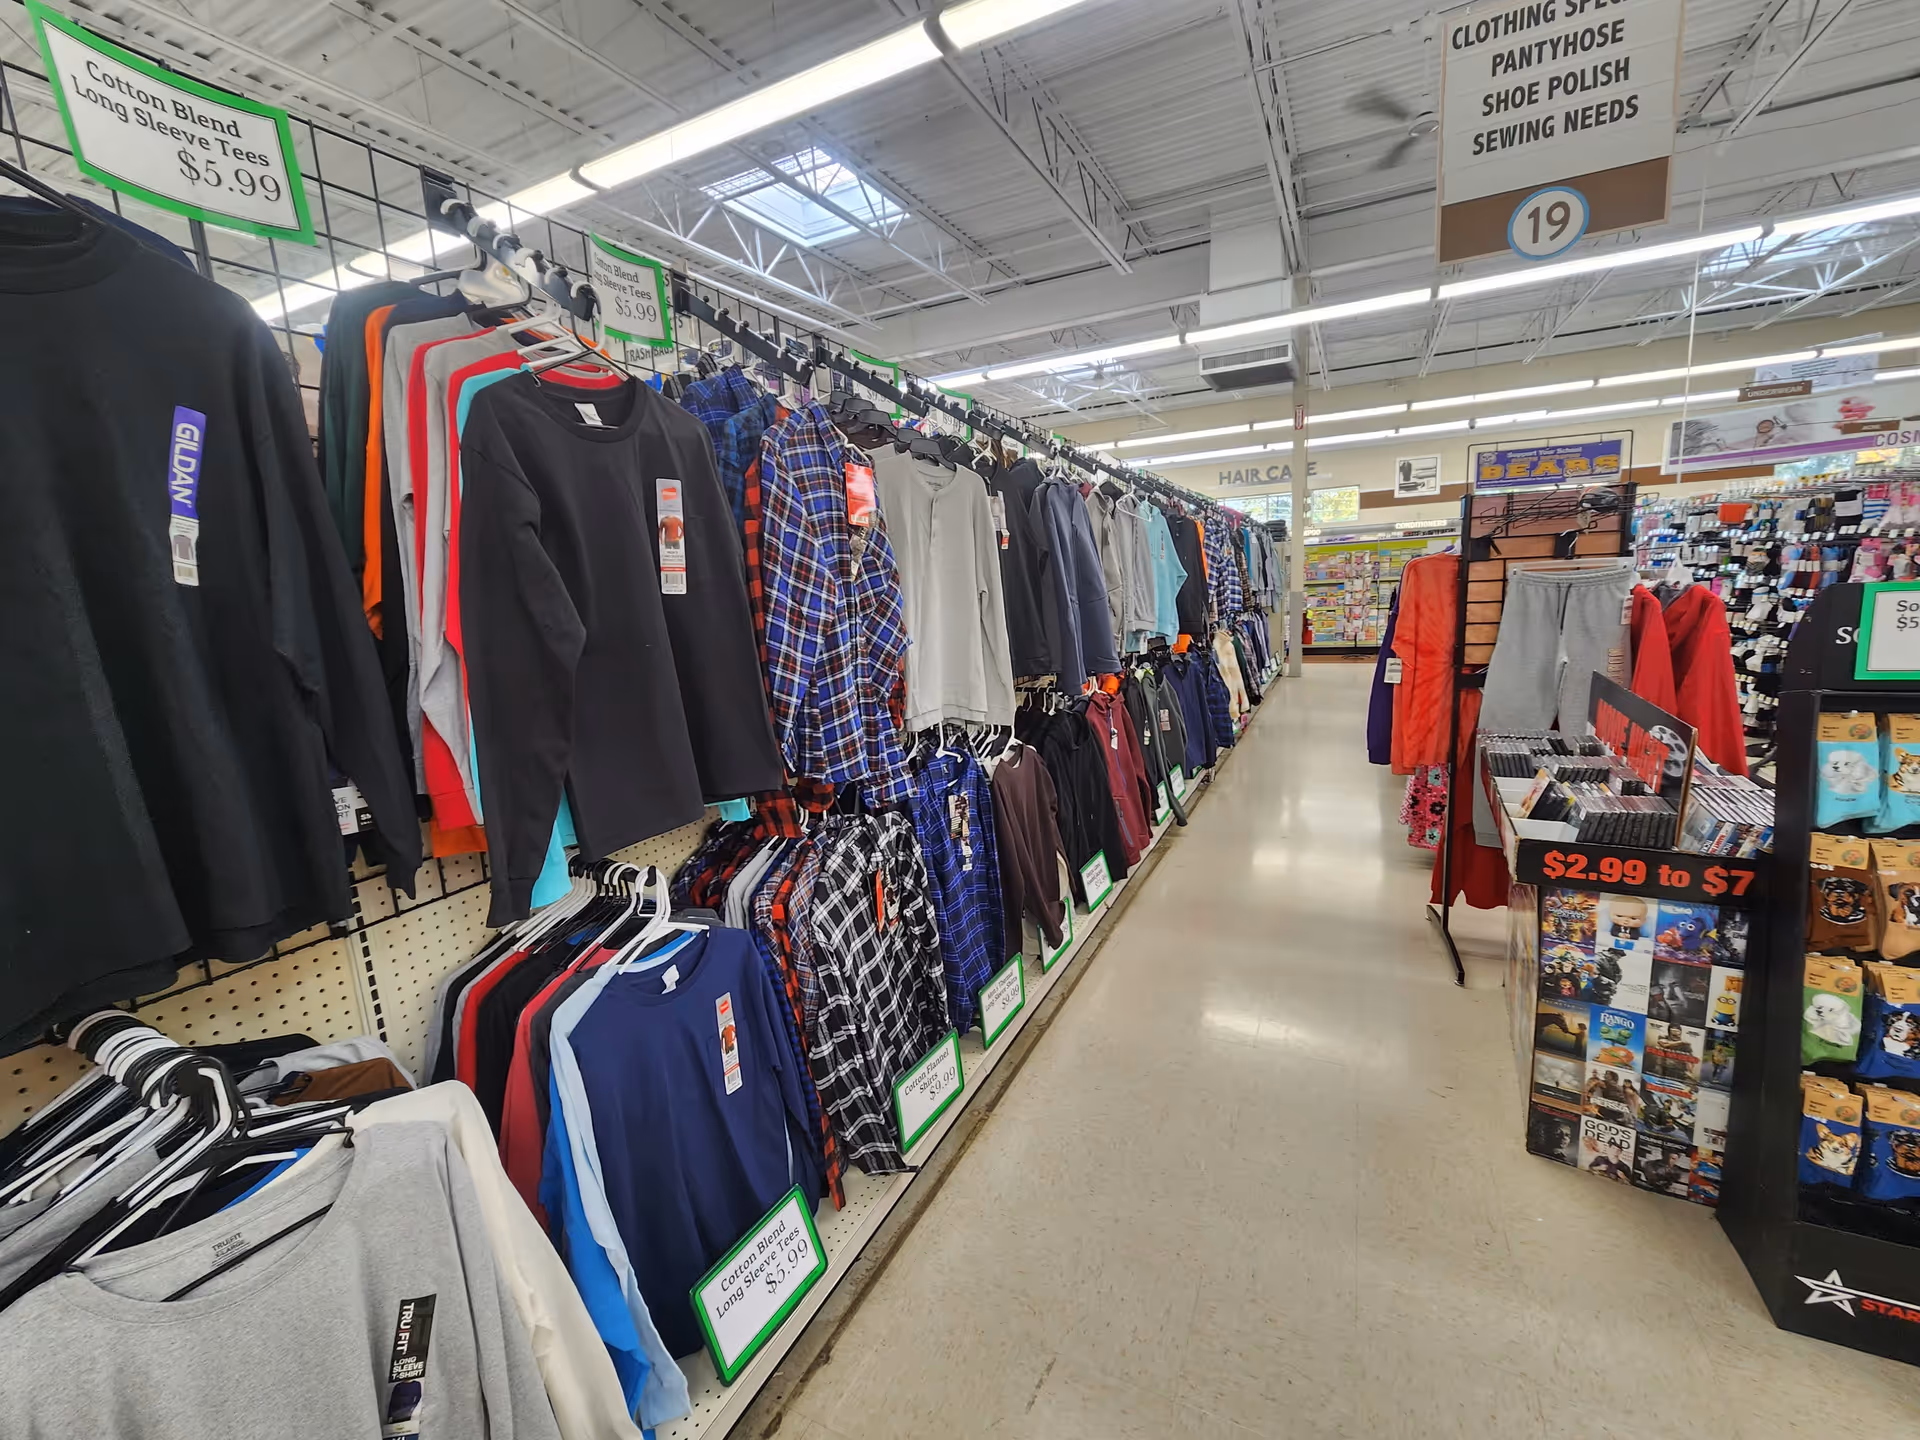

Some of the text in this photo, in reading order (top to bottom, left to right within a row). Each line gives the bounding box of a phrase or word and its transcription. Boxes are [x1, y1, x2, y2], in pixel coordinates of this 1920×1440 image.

[1452, 1, 1556, 50] CLOTHING
[1492, 19, 1626, 77] PANTYHOSE
[86, 60, 242, 138] Cotton Blend
[1482, 56, 1631, 117] SHOE POLISH
[71, 74, 271, 167] Long Sleeve Tees
[1472, 94, 1640, 156] SEWING NEEDS
[177, 147, 282, 203] $5.99
[1527, 200, 1572, 244] 19
[603, 274, 628, 295] Sleeve
[628, 284, 653, 301] Tees
[613, 264, 640, 284] Blend
[614, 296, 658, 323] $5.99
[170, 422, 200, 502] GILDAN
[1219, 462, 1318, 487] HAIR CAE
[1480, 454, 1620, 481] BEARS
[1835, 626, 1860, 645] S
[1543, 850, 1756, 896] $2.99 to $7
[1599, 1011, 1635, 1030] RANGO
[904, 1047, 950, 1096] Cotton Flannel
[919, 1072, 938, 1094] Shirts
[929, 1066, 956, 1101] $9.99
[1585, 1119, 1632, 1140] GOD'S
[1585, 1129, 1631, 1151] DEAD
[716, 1226, 801, 1319] Long Sleeve Tees
[720, 1220, 787, 1292] Cotton Blend
[765, 1238, 808, 1295] $5.99
[392, 1369, 424, 1380] T-SHIRT
[393, 1361, 424, 1374] SLEEVE
[394, 1356, 417, 1366] LONG
